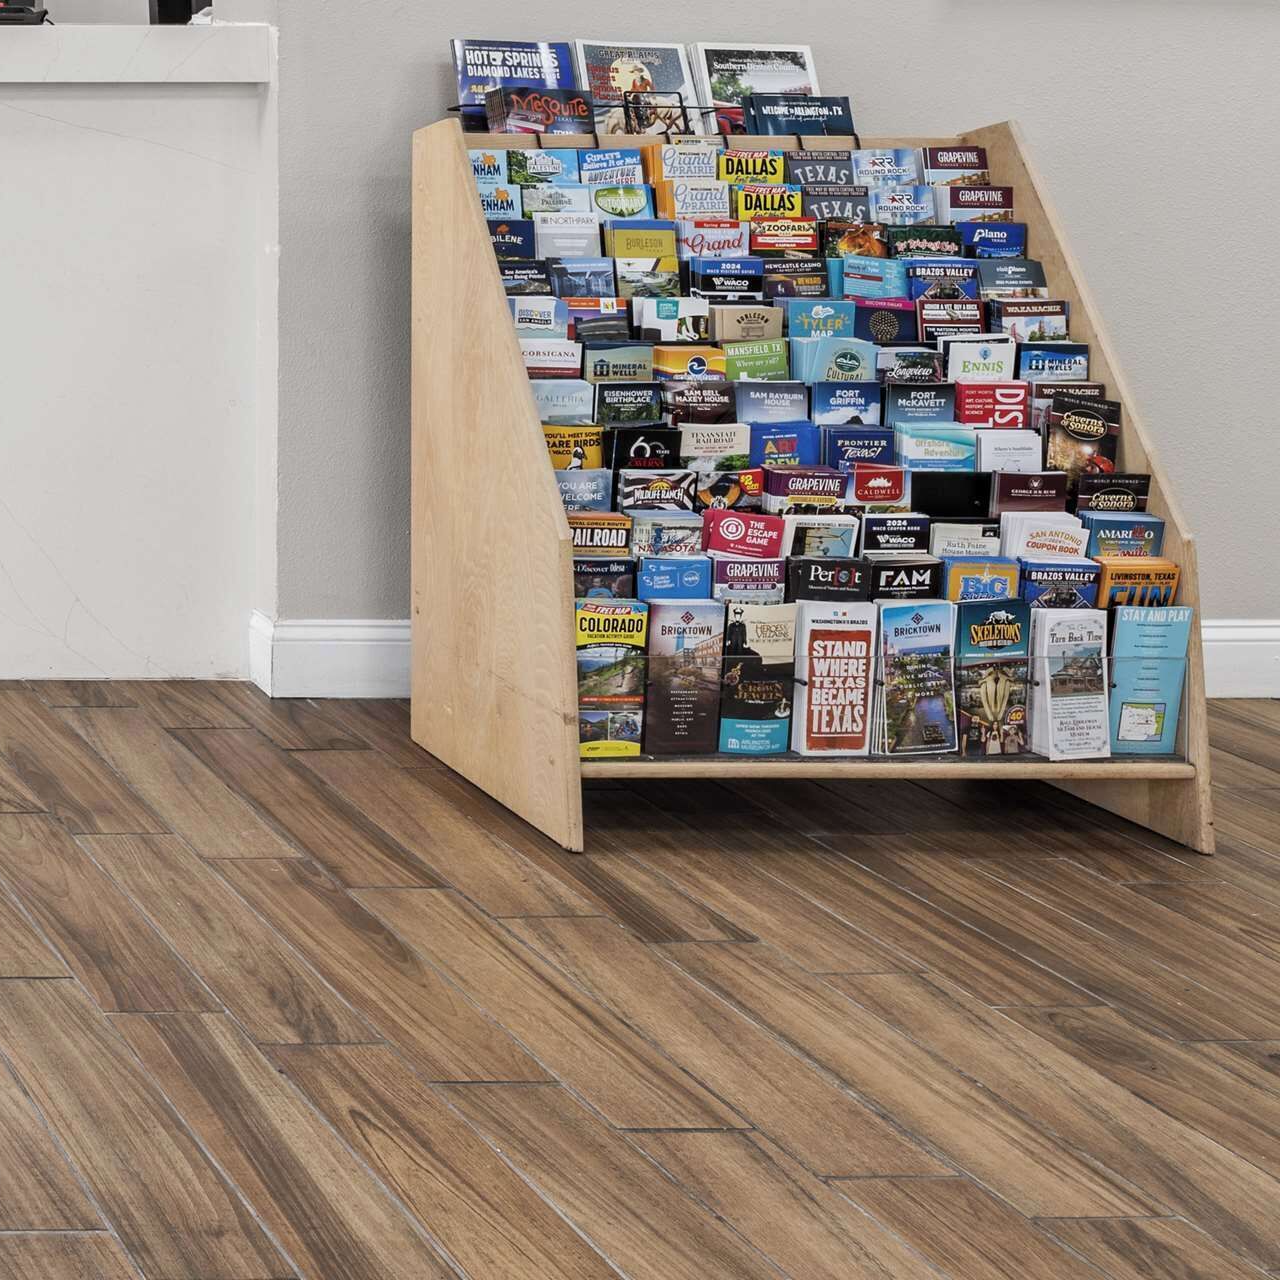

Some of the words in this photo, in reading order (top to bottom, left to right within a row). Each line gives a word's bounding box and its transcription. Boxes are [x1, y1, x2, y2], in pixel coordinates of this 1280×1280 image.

[465, 49, 489, 65] HOT
[505, 51, 559, 68] SPRINS
[713, 61, 747, 71] Southern
[466, 65, 510, 78] DIAMOND
[510, 66, 540, 79] LAKES
[663, 148, 713, 174] Grand
[937, 152, 979, 163] GRAPEVINE
[673, 165, 715, 175] PRAIRIE
[725, 157, 778, 176] DALLAS
[794, 165, 849, 185] TEXAS
[958, 191, 1003, 202] GRAPEVINE
[684, 201, 728, 211] PRAIRIE
[744, 193, 796, 212] DALLAS
[811, 199, 866, 219] TEXAS
[767, 224, 807, 232] ZOOFARI
[490, 235, 524, 245] BILENE
[685, 231, 744, 254] Grand
[915, 268, 945, 276] BRAZOS
[945, 268, 974, 277] VALLEY
[804, 318, 844, 330] TYLER
[810, 330, 834, 338] MAP
[522, 350, 576, 358] CORSICANA
[727, 345, 769, 356] MANSFIELD
[772, 344, 782, 353] TX
[611, 362, 647, 370] MINERAL
[961, 360, 1004, 373] ENNIS
[1047, 358, 1082, 366] MINERAL
[611, 369, 638, 377] WELLS
[604, 390, 653, 398] EISENHOWER
[701, 389, 721, 397] BELL
[749, 391, 767, 399] SAM
[768, 392, 804, 401] RAYBURN
[835, 390, 860, 398] FORT
[910, 391, 936, 399] FORT
[605, 396, 651, 404] BIRTHPLACE
[675, 395, 703, 403] MAXEY
[703, 395, 730, 403] HOUSE
[764, 398, 791, 406] HOUSE
[829, 397, 865, 405] GRIFFIN
[897, 398, 946, 407] McKAVETT
[1063, 412, 1104, 426] Caverns
[1069, 421, 1105, 434] Sonora
[546, 439, 571, 448] RARE
[573, 437, 601, 448] BIRDS
[837, 439, 888, 447] FRONTIER
[579, 481, 598, 490] ARE
[788, 477, 842, 492] GRAPEVINE
[661, 489, 684, 502] RANCH
[857, 488, 901, 496] CALDWELL
[1092, 493, 1133, 503] Caverns
[1098, 500, 1135, 509] Sonora
[749, 520, 765, 530] THE
[747, 528, 779, 540] ESCAPE
[886, 534, 916, 544] WACO
[1029, 531, 1048, 540] SAN
[1048, 530, 1083, 546] ANTONIO
[746, 537, 769, 546] GAME
[637, 544, 697, 553] NAVASOTA
[1026, 540, 1058, 552] COUPON
[1058, 545, 1080, 555] BOOK
[726, 563, 779, 577] GRAPEVINE
[1031, 571, 1063, 581] BRAZOS
[1065, 572, 1096, 581] VALLEY
[1110, 572, 1153, 581] LIVINGSTON,
[1154, 572, 1176, 581] TEXAS
[1108, 586, 1173, 608] FUN
[595, 606, 616, 616] FREE
[615, 606, 632, 616] MAP
[1121, 608, 1147, 621] STAY
[1147, 609, 1166, 622] AND
[1167, 609, 1191, 622] PLAY
[579, 616, 643, 633] COLORADO
[660, 624, 713, 636] BRICKTOWN
[893, 623, 942, 637] BRICKTOWN
[970, 623, 1021, 645] SKELETONS
[1050, 632, 1066, 644] Turn
[1067, 631, 1084, 643] Back
[812, 640, 867, 657] STAND
[813, 658, 866, 677] WHERE
[812, 677, 866, 689] TEXAS
[812, 688, 865, 705] BECAME
[810, 704, 865, 733] TEXAS
